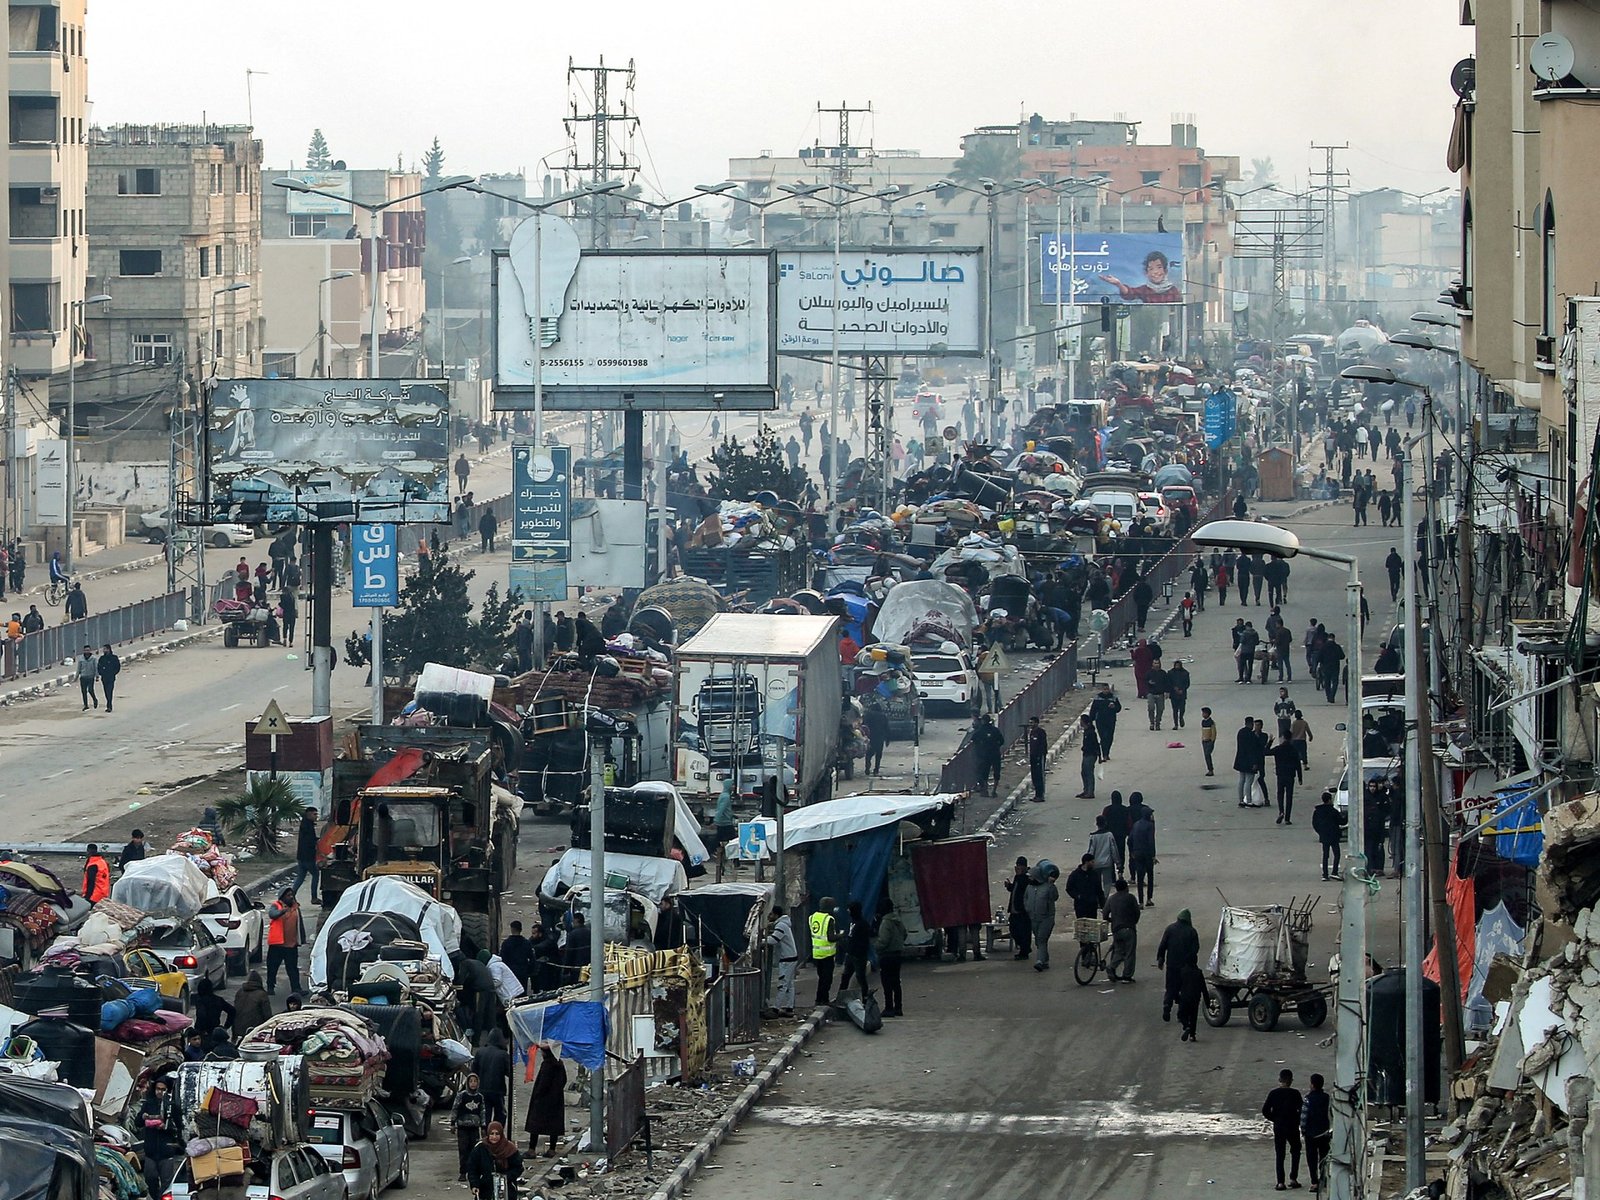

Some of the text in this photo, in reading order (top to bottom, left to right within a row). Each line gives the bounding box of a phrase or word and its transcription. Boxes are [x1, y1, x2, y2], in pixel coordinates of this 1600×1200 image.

[1048, 241, 1109, 260] غزة
[841, 261, 965, 290] صالوني
[707, 296, 746, 314] للأدوات
[877, 298, 948, 313] للسيراميك
[798, 318, 948, 336] والأدوات الصحية
[540, 359, 648, 367] 8-2556155 0599601988
[365, 387, 411, 403] شركة
[520, 489, 561, 500] خبراء
[519, 504, 561, 515] للتدريب
[520, 518, 561, 529] والتطوير
